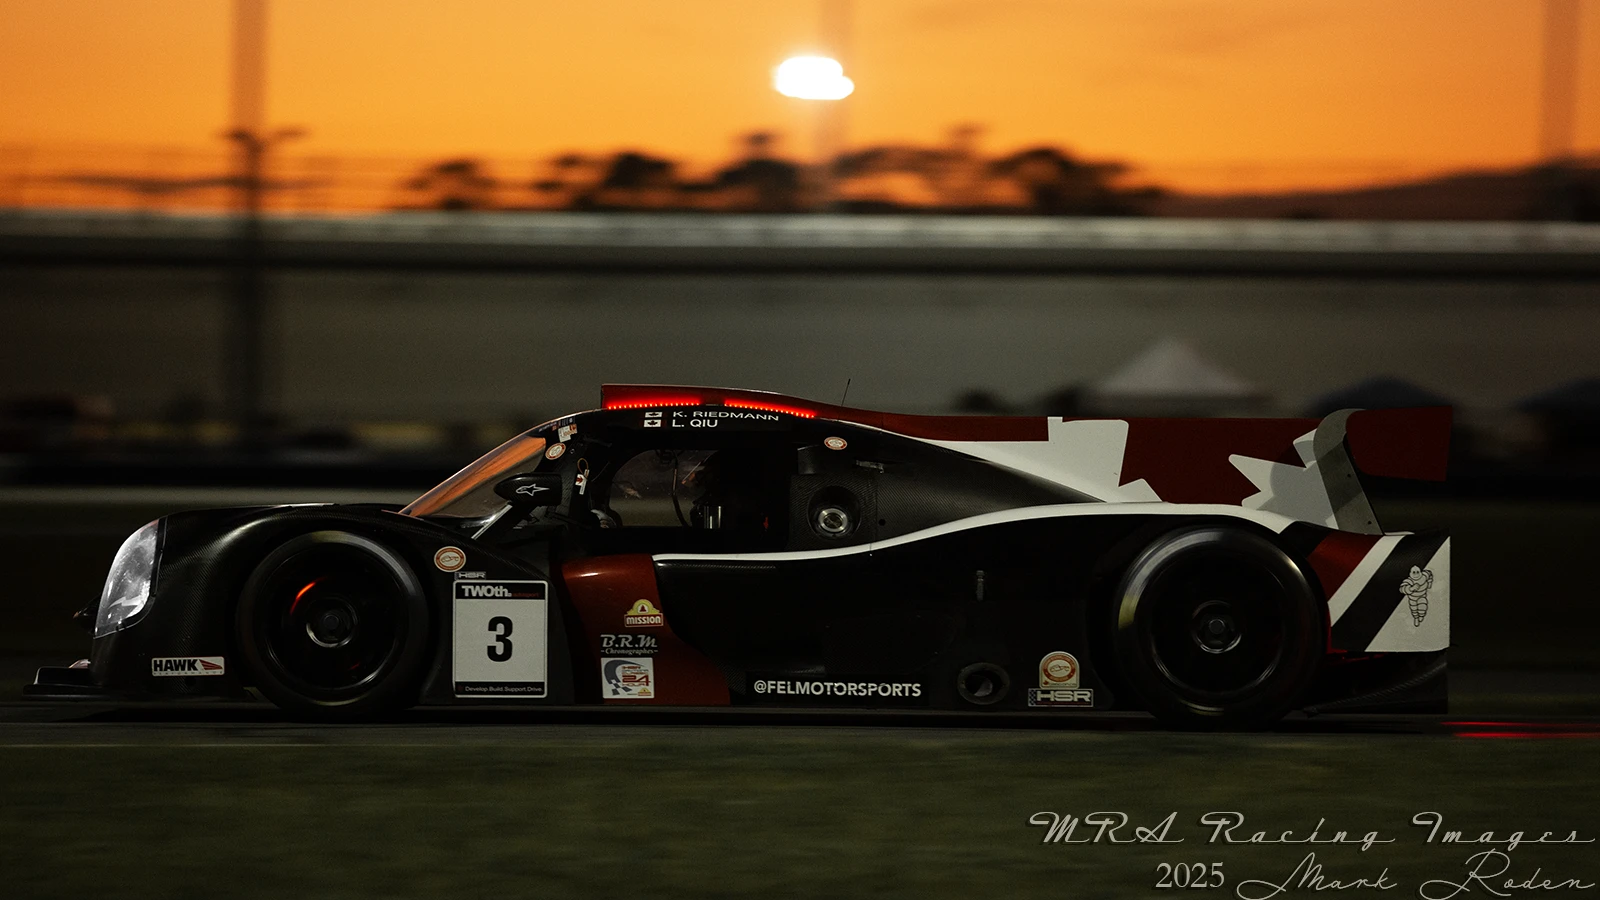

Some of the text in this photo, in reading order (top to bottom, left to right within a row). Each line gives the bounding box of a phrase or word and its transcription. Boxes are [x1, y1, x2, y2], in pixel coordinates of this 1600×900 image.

[693, 411, 779, 421] RIEDMANN
[671, 419, 719, 428] L. QIU
[487, 616, 513, 662] 3
[154, 659, 198, 671] HAWK
[754, 680, 922, 697] @FELMOTORSPORTS
[1036, 690, 1091, 702] HSR
